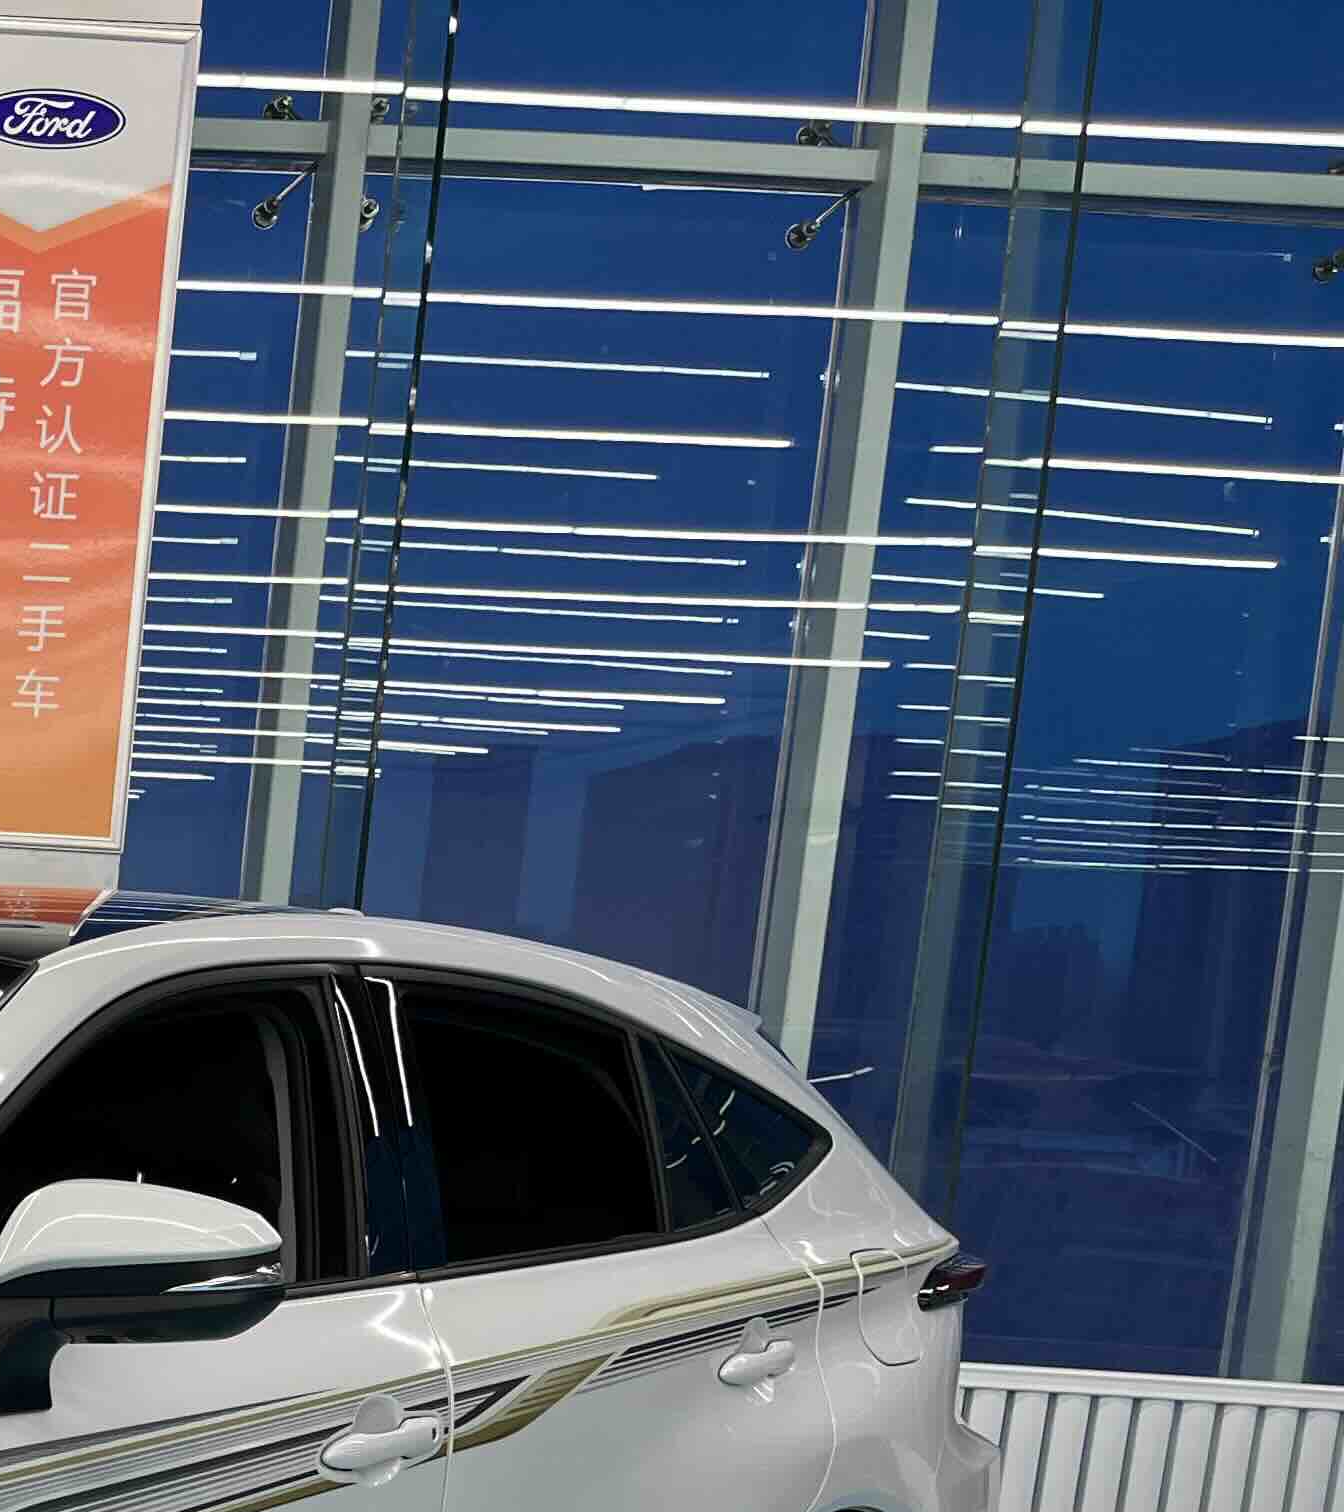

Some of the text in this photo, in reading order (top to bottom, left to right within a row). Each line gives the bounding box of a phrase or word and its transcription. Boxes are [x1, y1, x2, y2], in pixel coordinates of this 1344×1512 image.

[2, 96, 96, 140] Ford
[11, 268, 98, 719] 官方认证二手车
